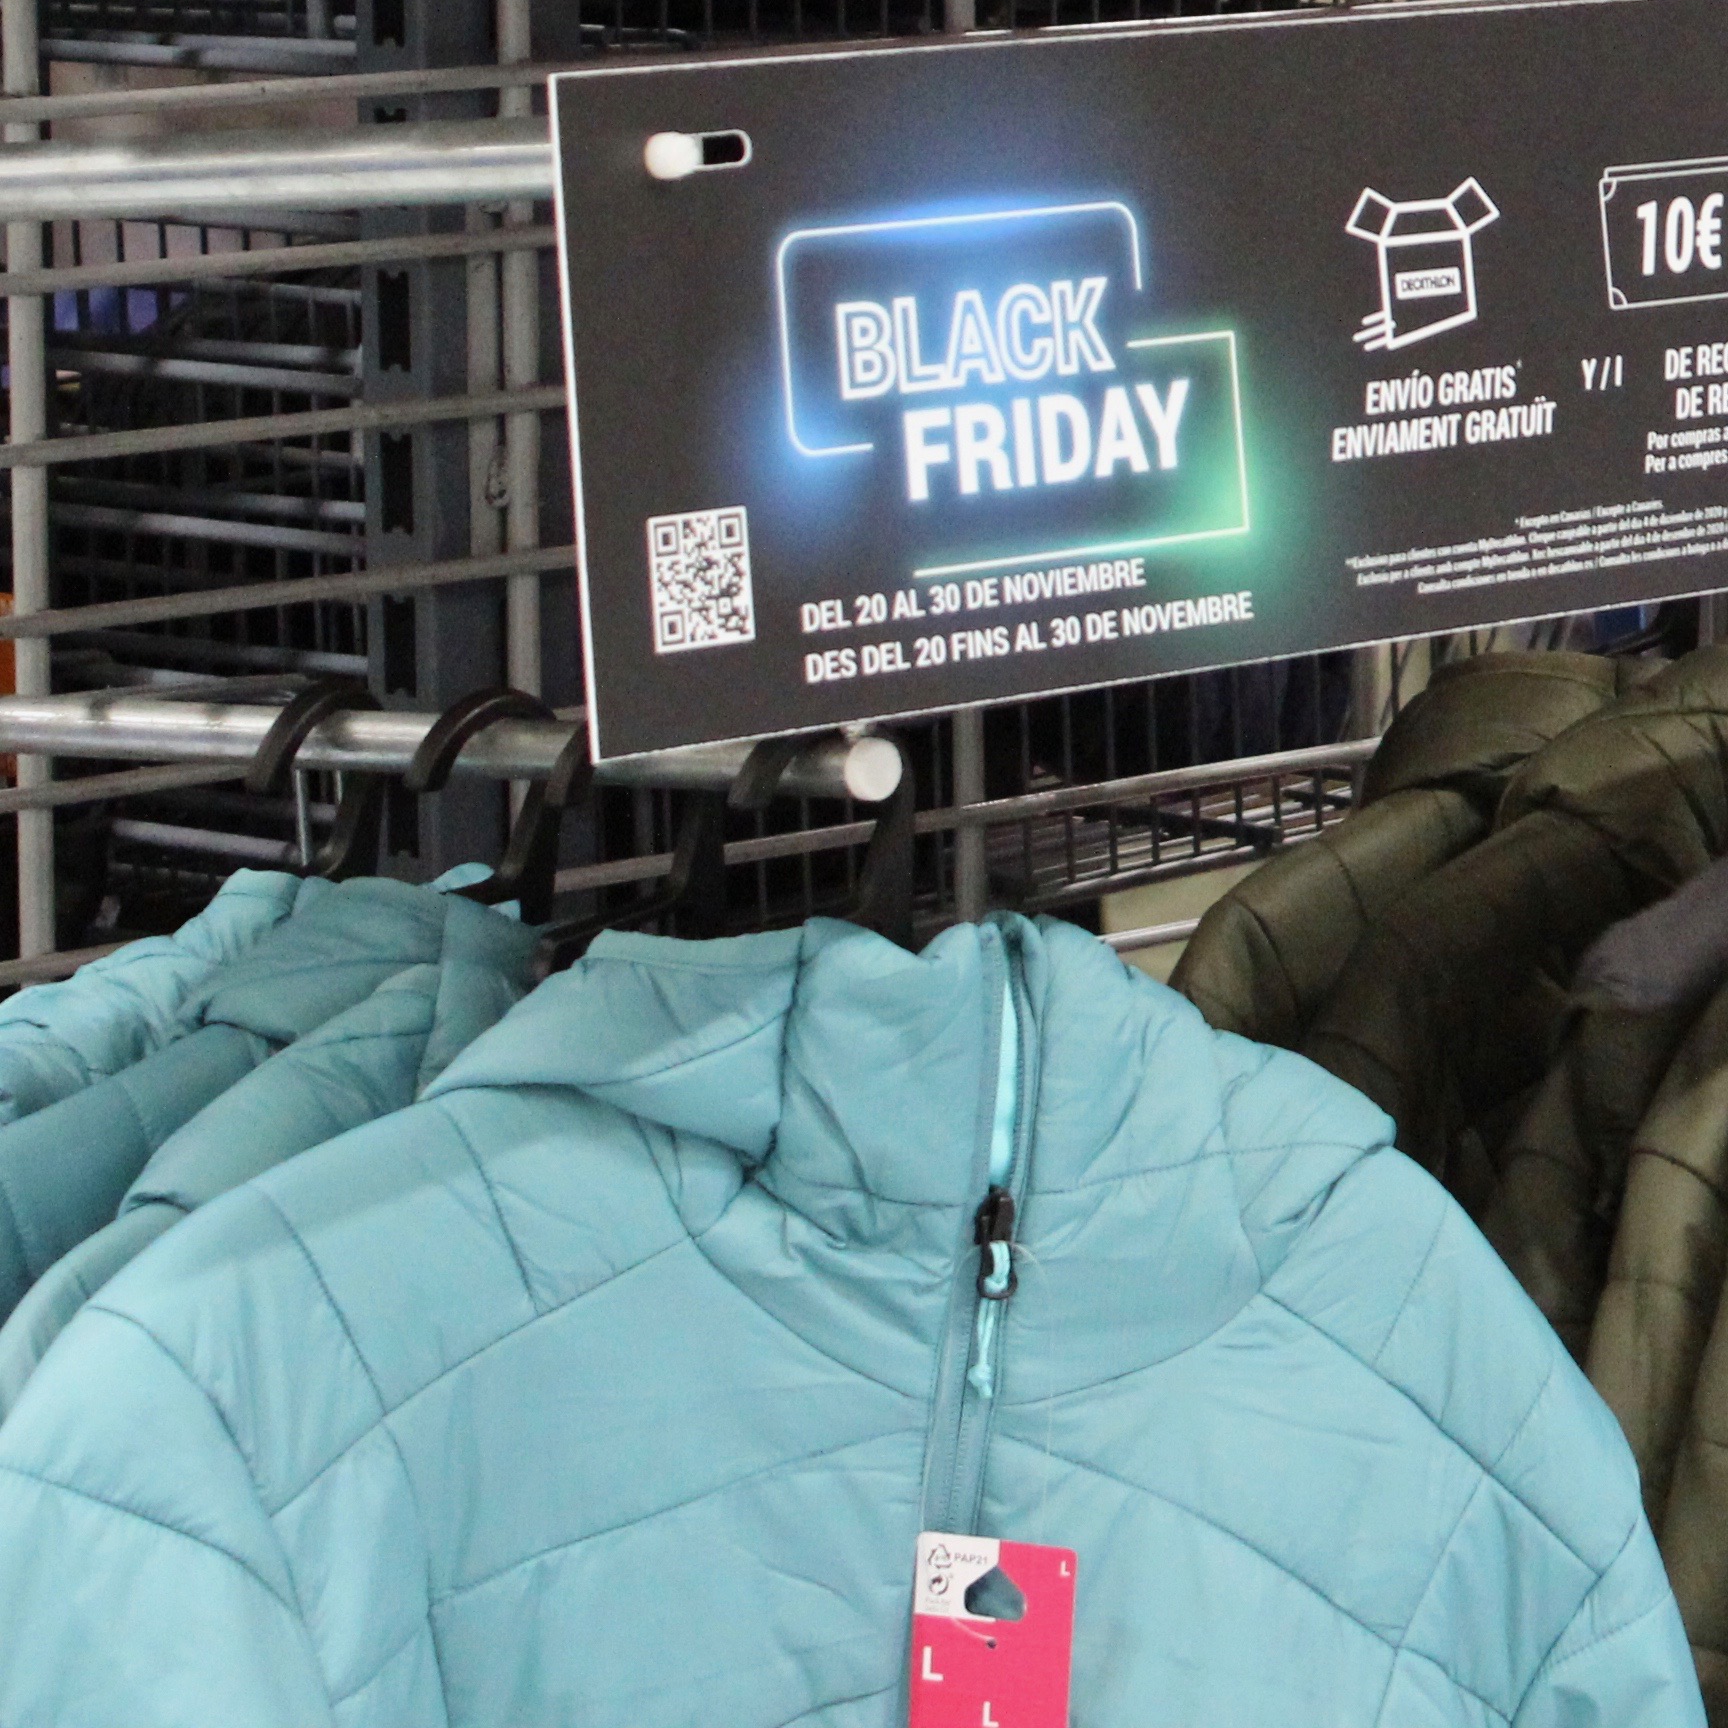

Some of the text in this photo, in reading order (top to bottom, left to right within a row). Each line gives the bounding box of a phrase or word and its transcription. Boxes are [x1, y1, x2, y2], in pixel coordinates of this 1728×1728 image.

[1637, 192, 1723, 275] 10€
[835, 276, 1115, 400] BLACK
[1664, 346, 1692, 381] DE
[1365, 368, 1433, 415] ENVÍO
[1676, 385, 1703, 419] DE
[902, 377, 1191, 502] FRIDAY
[1332, 395, 1556, 462] ENVIAMENT GRATUÏT
[1646, 431, 1669, 451] Por
[1670, 427, 1721, 449] compras
[1645, 453, 1666, 473] Per
[1676, 447, 1728, 470] compres
[801, 558, 1146, 632] DEL 20 AL 30 DE NOVIEMBRE
[805, 590, 1254, 683] DES DEL 20 FINS AL 30 DE NOVEMBRE
[1060, 1561, 1070, 1576] L
[922, 1645, 944, 1681] L
[982, 1700, 999, 1728] L
